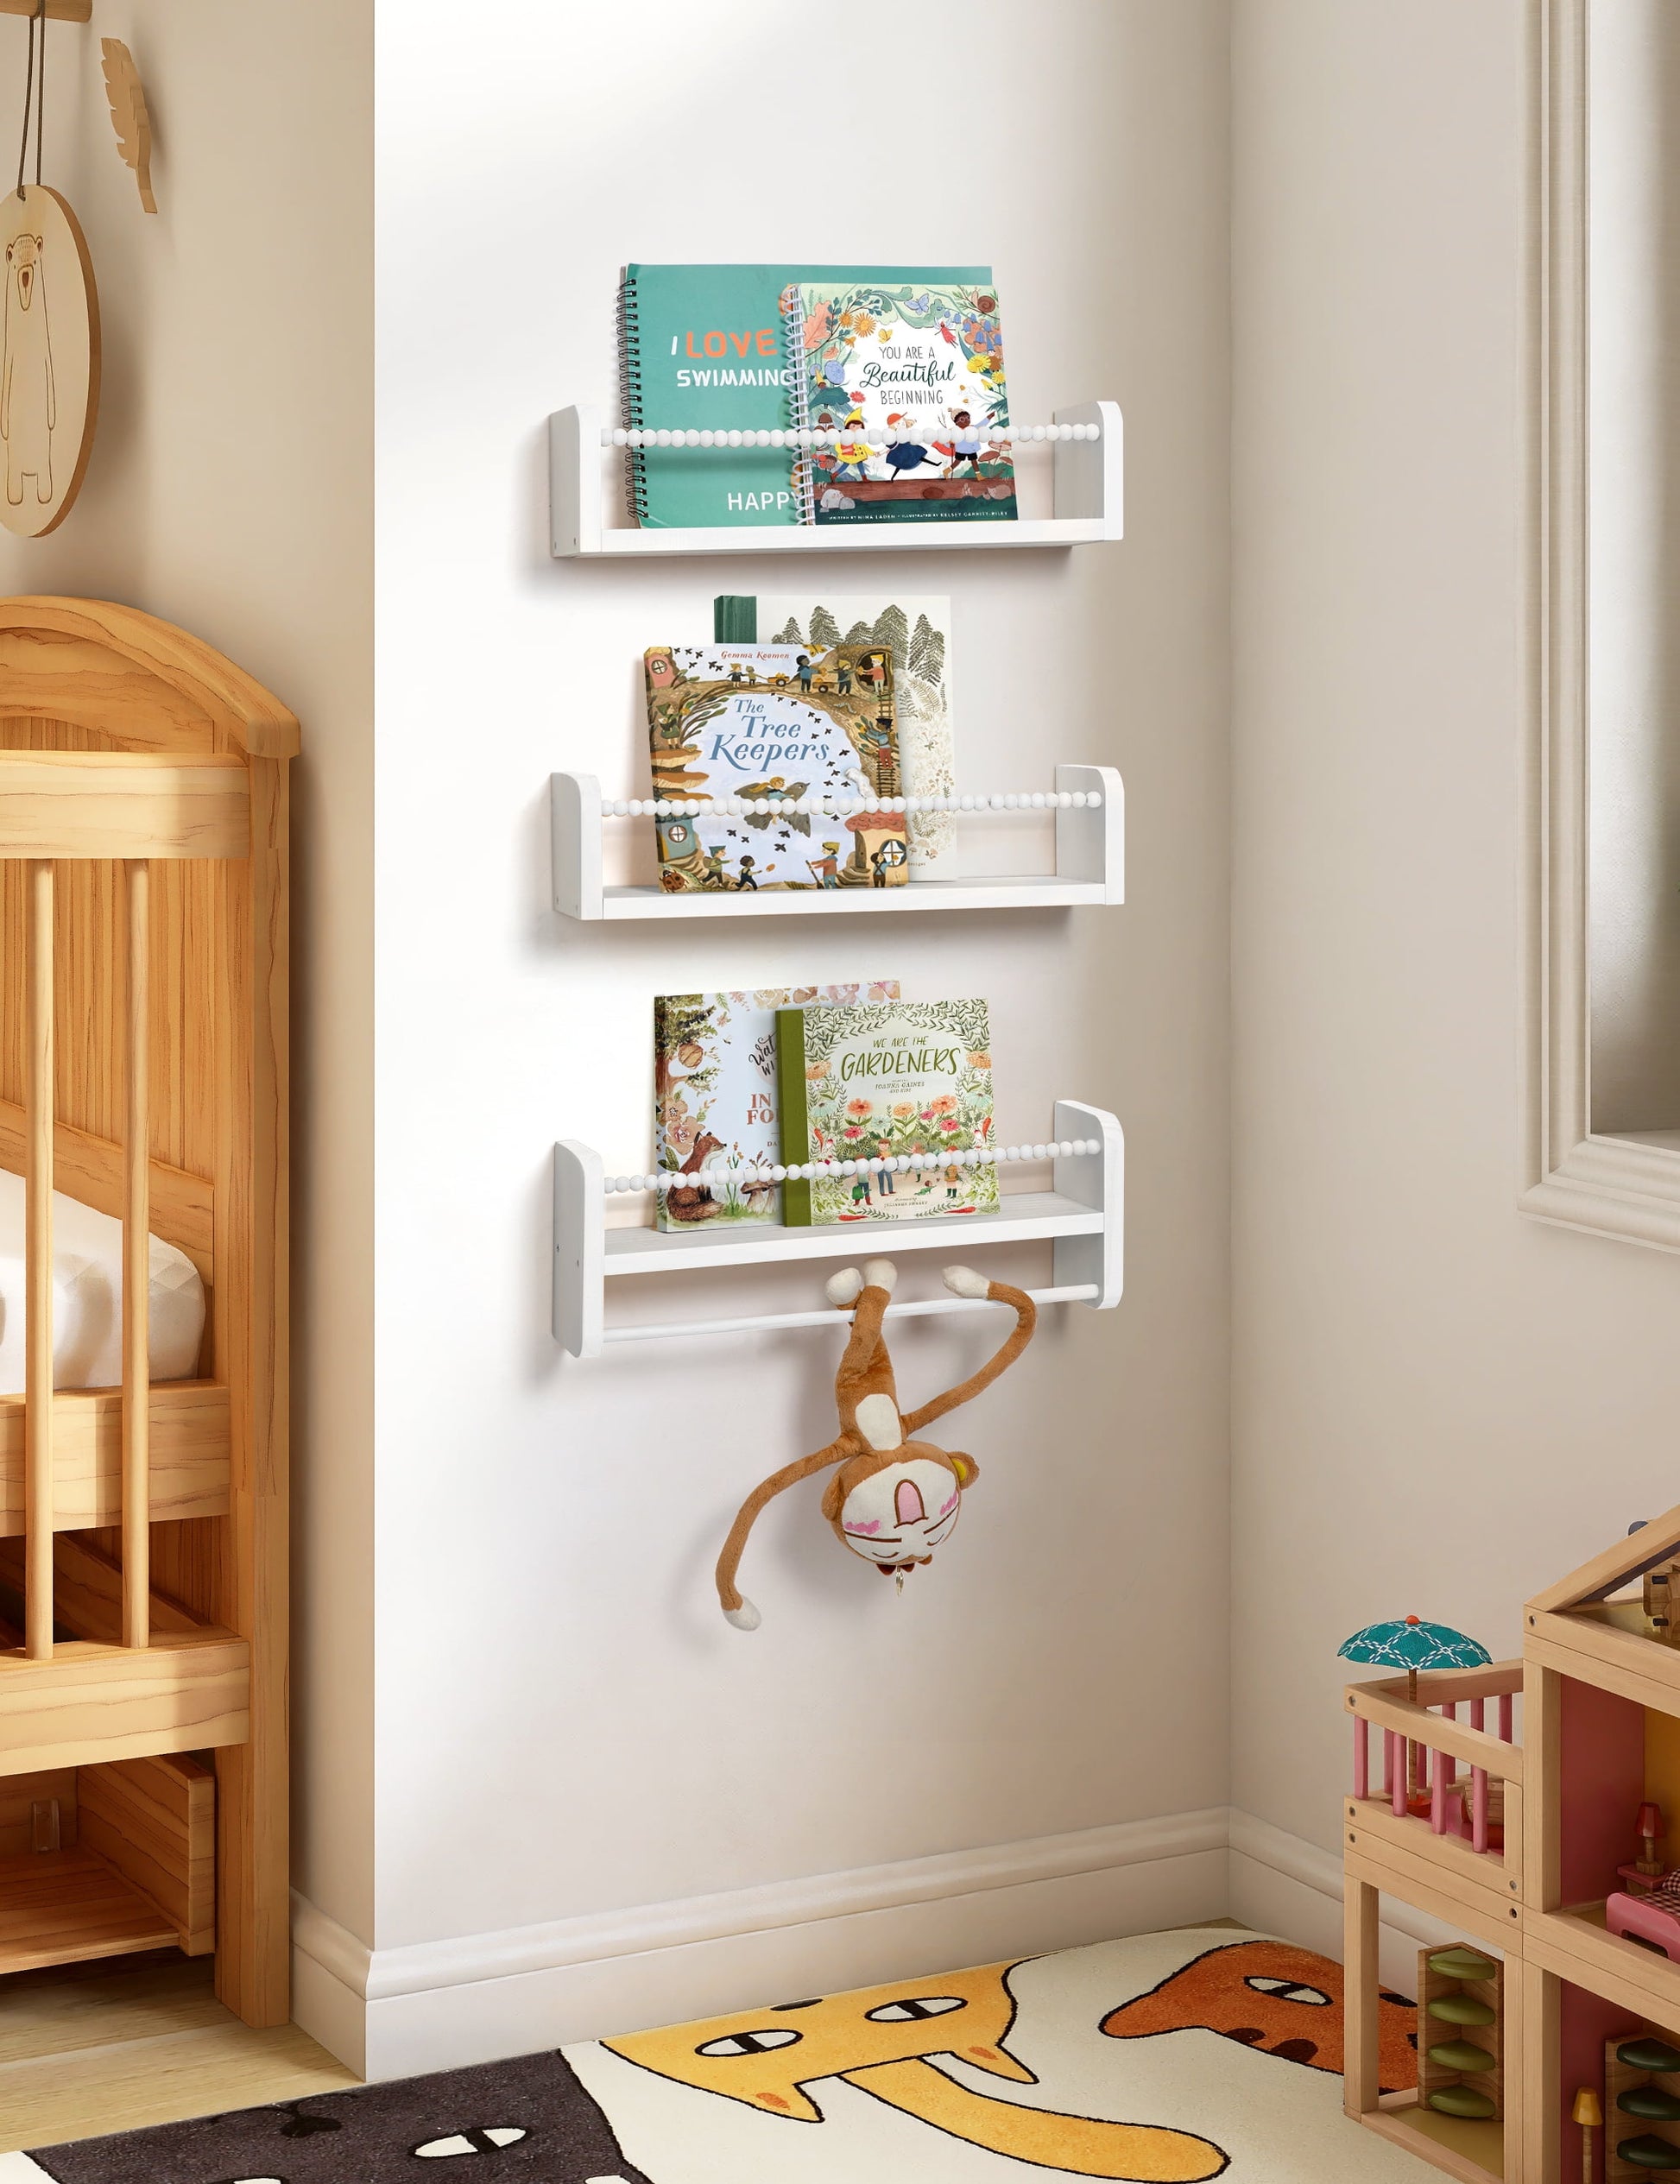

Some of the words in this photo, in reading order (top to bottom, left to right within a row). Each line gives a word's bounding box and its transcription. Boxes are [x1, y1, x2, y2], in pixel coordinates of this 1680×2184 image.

[671, 336, 679, 356] I
[685, 328, 778, 358] LOVE
[879, 346, 901, 359] YOU
[906, 346, 924, 359] ARE
[928, 346, 936, 359] A
[677, 369, 795, 387] SWIMMING
[859, 360, 957, 388] Beautiful
[881, 389, 944, 405] BEGINNING
[721, 650, 754, 660] Gemma
[734, 698, 765, 713] The
[741, 715, 801, 738] Tree
[708, 734, 830, 772] Keepers
[873, 1038, 887, 1048] WE
[891, 1037, 909, 1047] ARE
[913, 1036, 930, 1046] THE
[841, 1047, 961, 1082] GARDENERS
[750, 1093, 772, 1108] IN
[747, 1108, 779, 1125] FO
